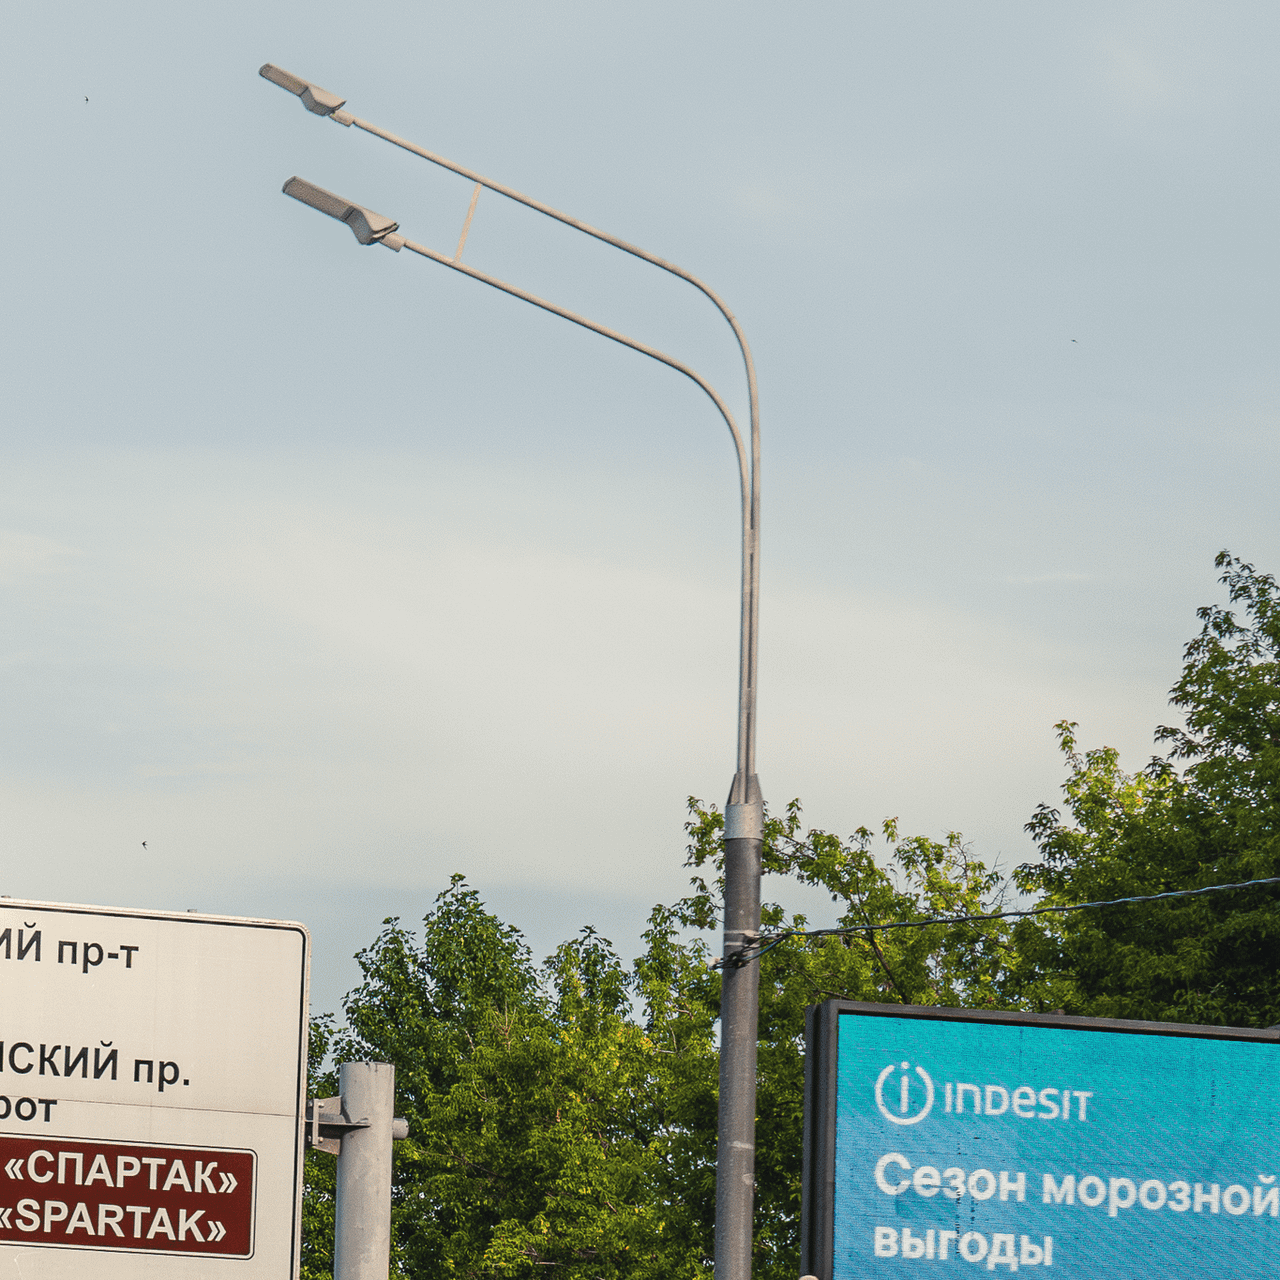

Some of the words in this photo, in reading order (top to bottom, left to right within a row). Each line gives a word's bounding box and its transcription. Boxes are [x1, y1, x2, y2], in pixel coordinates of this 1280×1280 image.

[57, 940, 139, 974] пр-т
[133, 1059, 190, 1093] пр.
[4, 1149, 238, 1194] «СПАРТАК»
[873, 1152, 1026, 1203] Сезон
[1042, 1174, 1279, 1218] морозной
[873, 1225, 1054, 1272] выгоды
